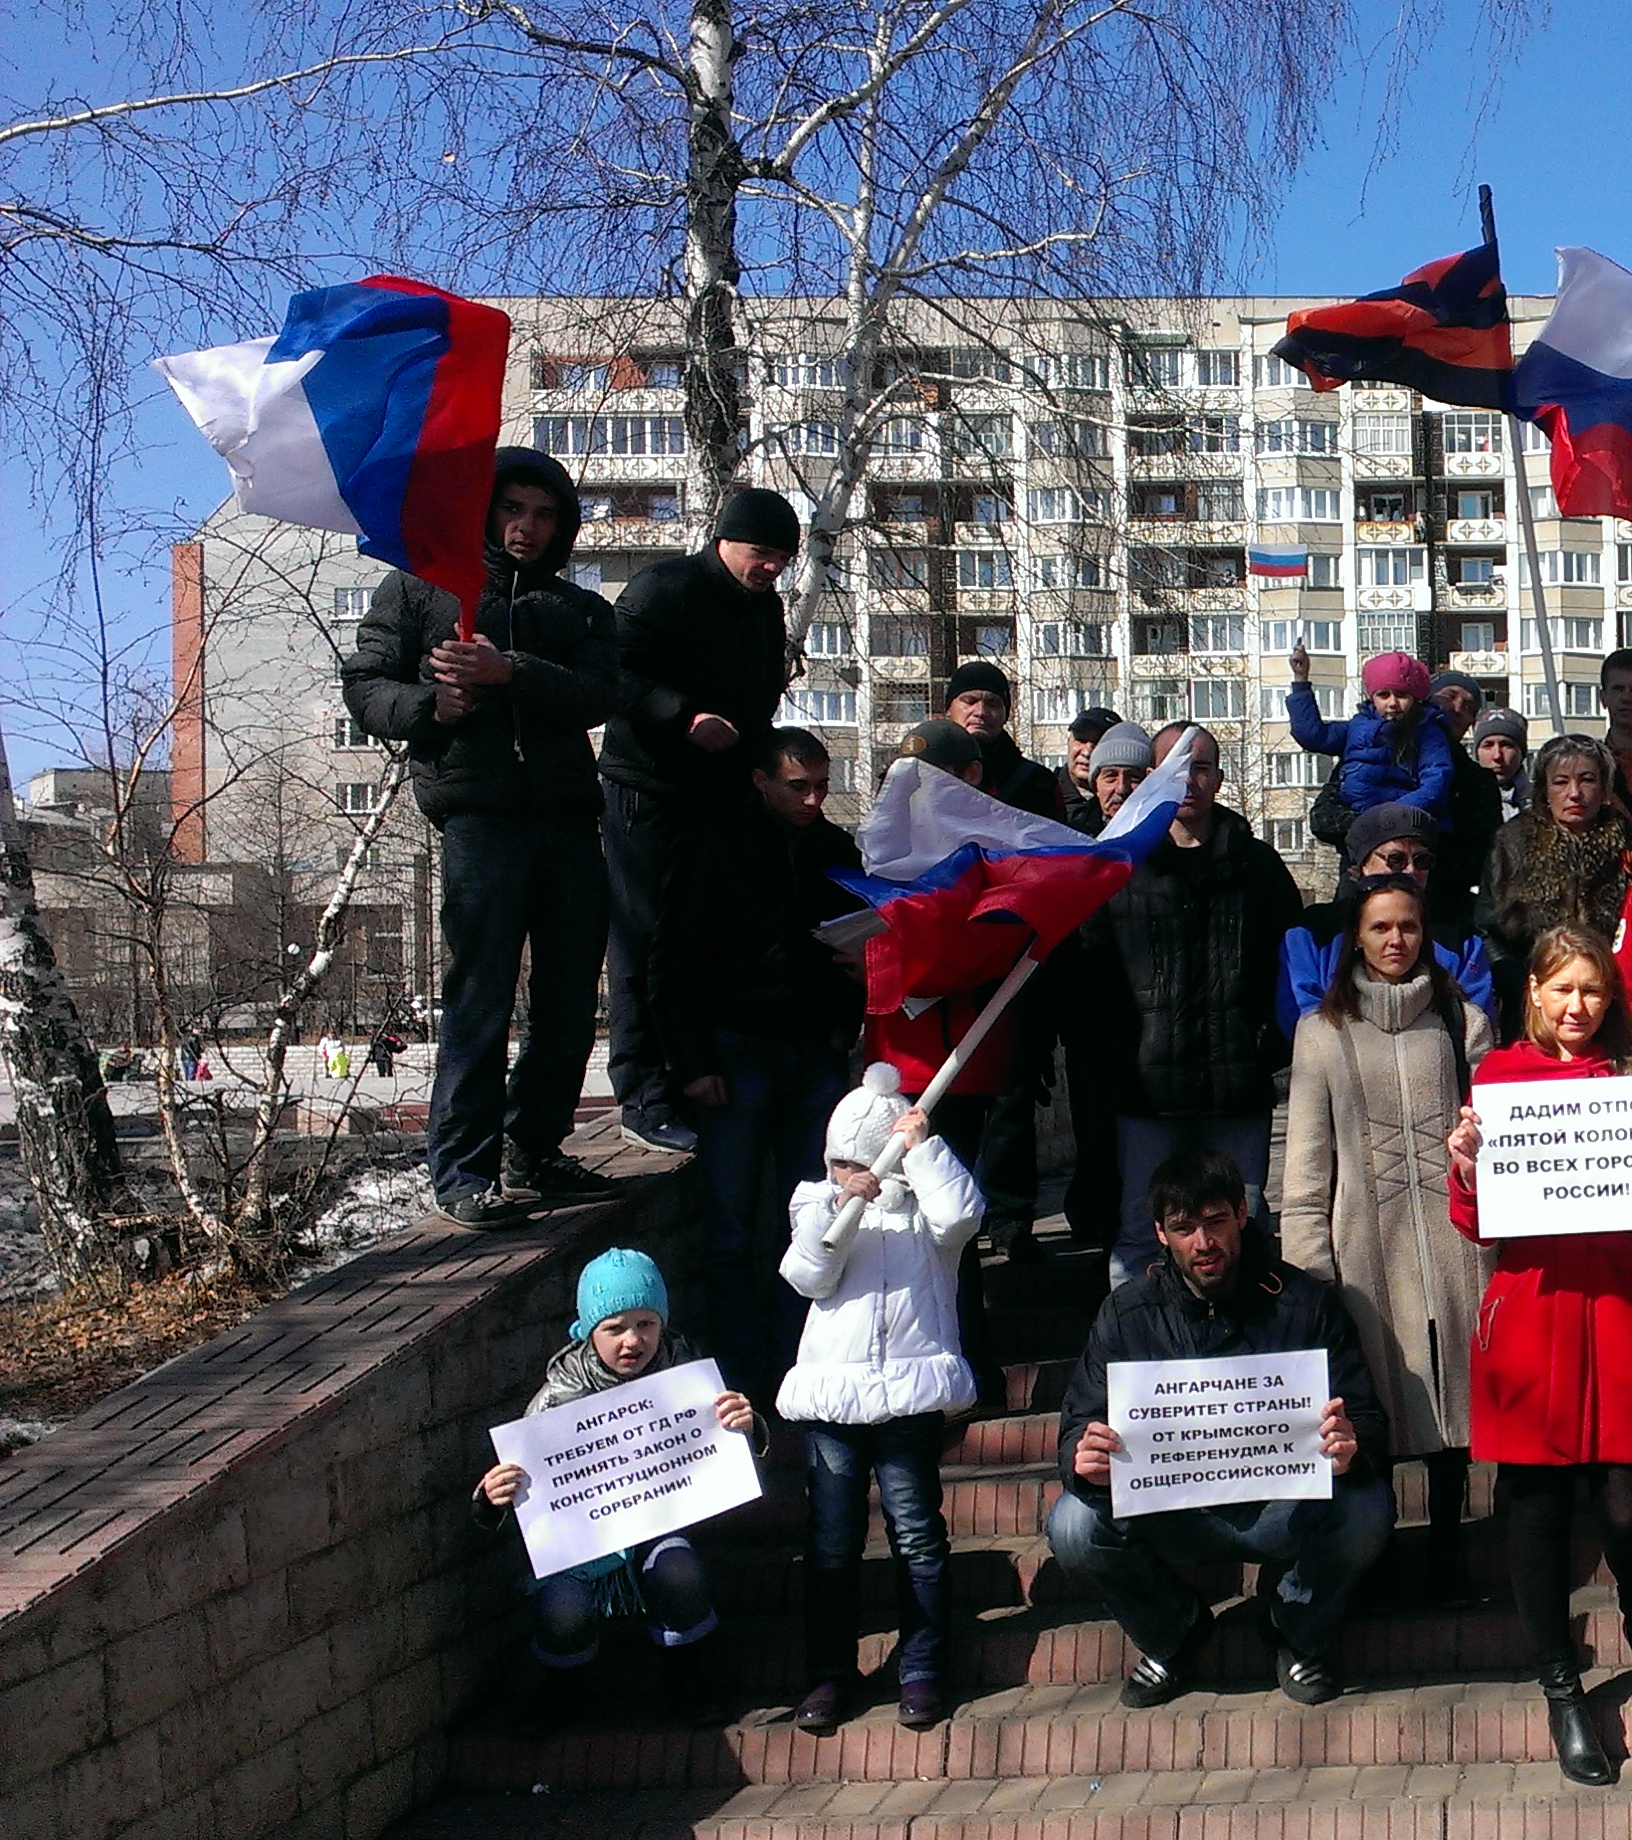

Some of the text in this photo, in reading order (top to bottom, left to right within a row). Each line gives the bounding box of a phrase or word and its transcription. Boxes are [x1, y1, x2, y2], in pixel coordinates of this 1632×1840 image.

[1509, 1102, 1581, 1121] ДАДИМ
[1487, 1128, 1567, 1148] «ПЯТОЙ
[1493, 1161, 1519, 1174] ВО
[1526, 1158, 1578, 1173] ВСЕХ
[1543, 1183, 1630, 1200] РОССИИ!
[1154, 1375, 1284, 1395] АНГАРЧАНЕ ЗА
[575, 1398, 655, 1433] АНГАРСК:
[1128, 1397, 1312, 1420] СУВЕРИТЕТ СТРАНЫ!
[543, 1408, 698, 1467] ТРЕБУЕМ ОТ ГД РФ
[1152, 1423, 1290, 1443] ОТ КРЫМСКОГО
[552, 1427, 703, 1488] ПРИНЯТЬ ЗАКОН О
[1150, 1442, 1294, 1465] РЕФЕРЕНУДМА К
[549, 1444, 718, 1512] КОНСТИТУЦИОННОМ
[1130, 1462, 1316, 1490] ОБЩЕРОССИЙСКОМУ!
[589, 1476, 693, 1521] СОРБРАНИИ!
